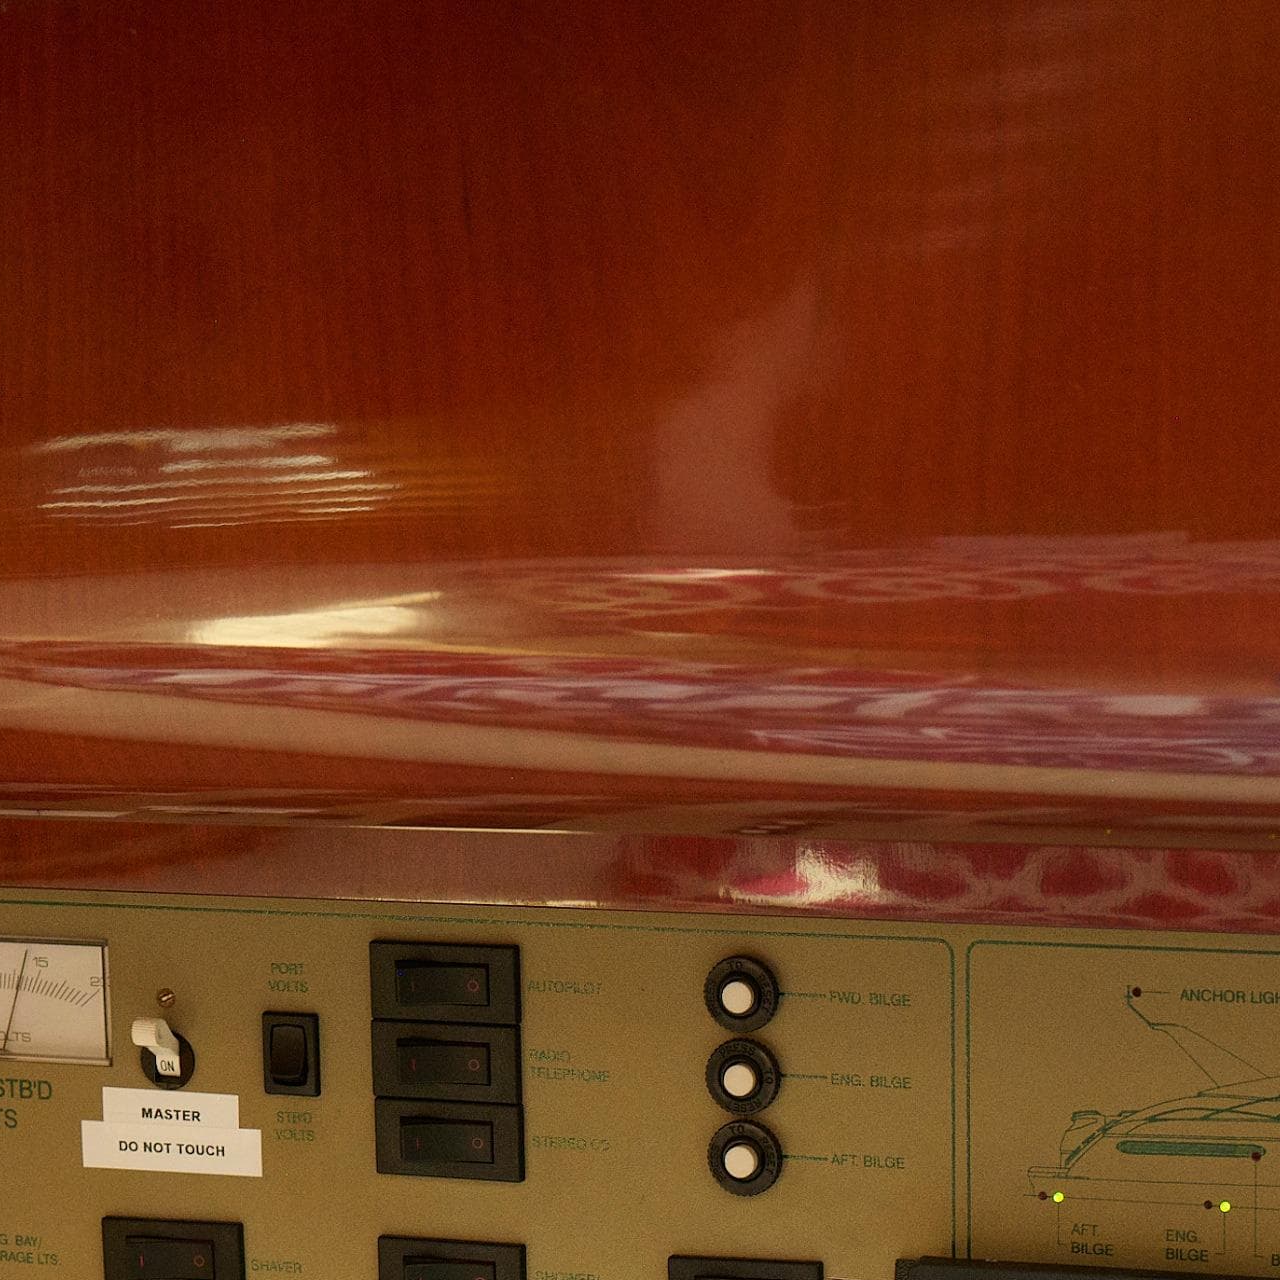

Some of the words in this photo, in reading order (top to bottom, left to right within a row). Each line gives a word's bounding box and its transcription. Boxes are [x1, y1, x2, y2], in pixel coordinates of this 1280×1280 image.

[34, 956, 49, 968] 15
[270, 962, 305, 975] PORT
[267, 979, 310, 994] VOLTS
[527, 981, 602, 996] AUTOPILOT
[868, 992, 913, 1008] BILGE
[1179, 988, 1247, 1005] ANCHOR
[160, 1058, 176, 1073] ON
[529, 1066, 610, 1083] TELEPHONE
[869, 1075, 913, 1090] BILGE
[141, 1107, 202, 1123] MASTER
[273, 1127, 316, 1142] VOLTS
[118, 1140, 139, 1153] DO
[143, 1141, 173, 1155] NOT
[175, 1142, 226, 1157] TOUCH
[863, 1155, 906, 1170] BILGE
[1070, 1240, 1115, 1258] BILGE
[1165, 1246, 1209, 1263] BILGE
[251, 1258, 303, 1274] SHAVER
